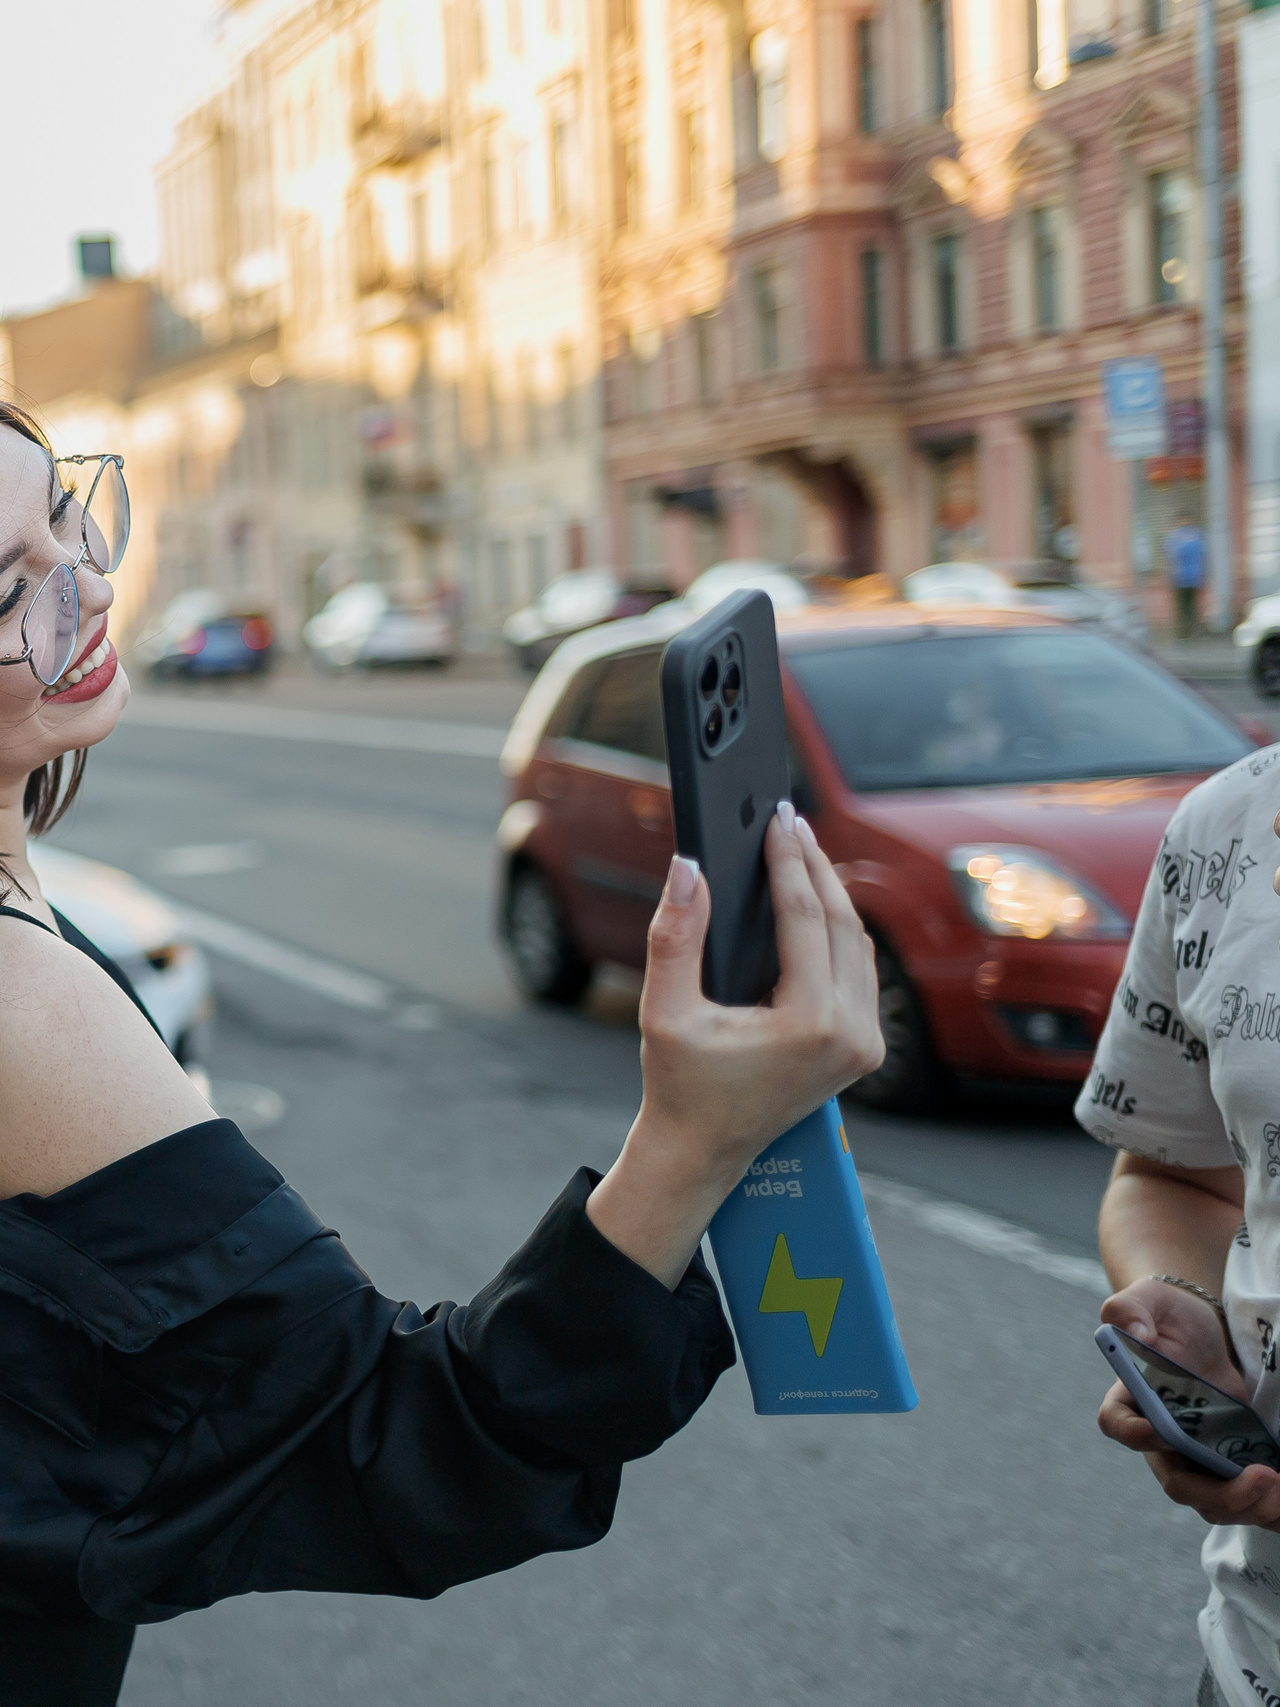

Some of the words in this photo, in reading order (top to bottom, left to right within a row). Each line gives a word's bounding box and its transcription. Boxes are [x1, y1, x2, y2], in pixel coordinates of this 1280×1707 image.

[1141, 1001, 1208, 1062] Ang
[746, 1158, 803, 1176] заря
[743, 1179, 803, 1198] Бери
[779, 1389, 829, 1401] телефон?
[831, 1388, 879, 1399] Садится
